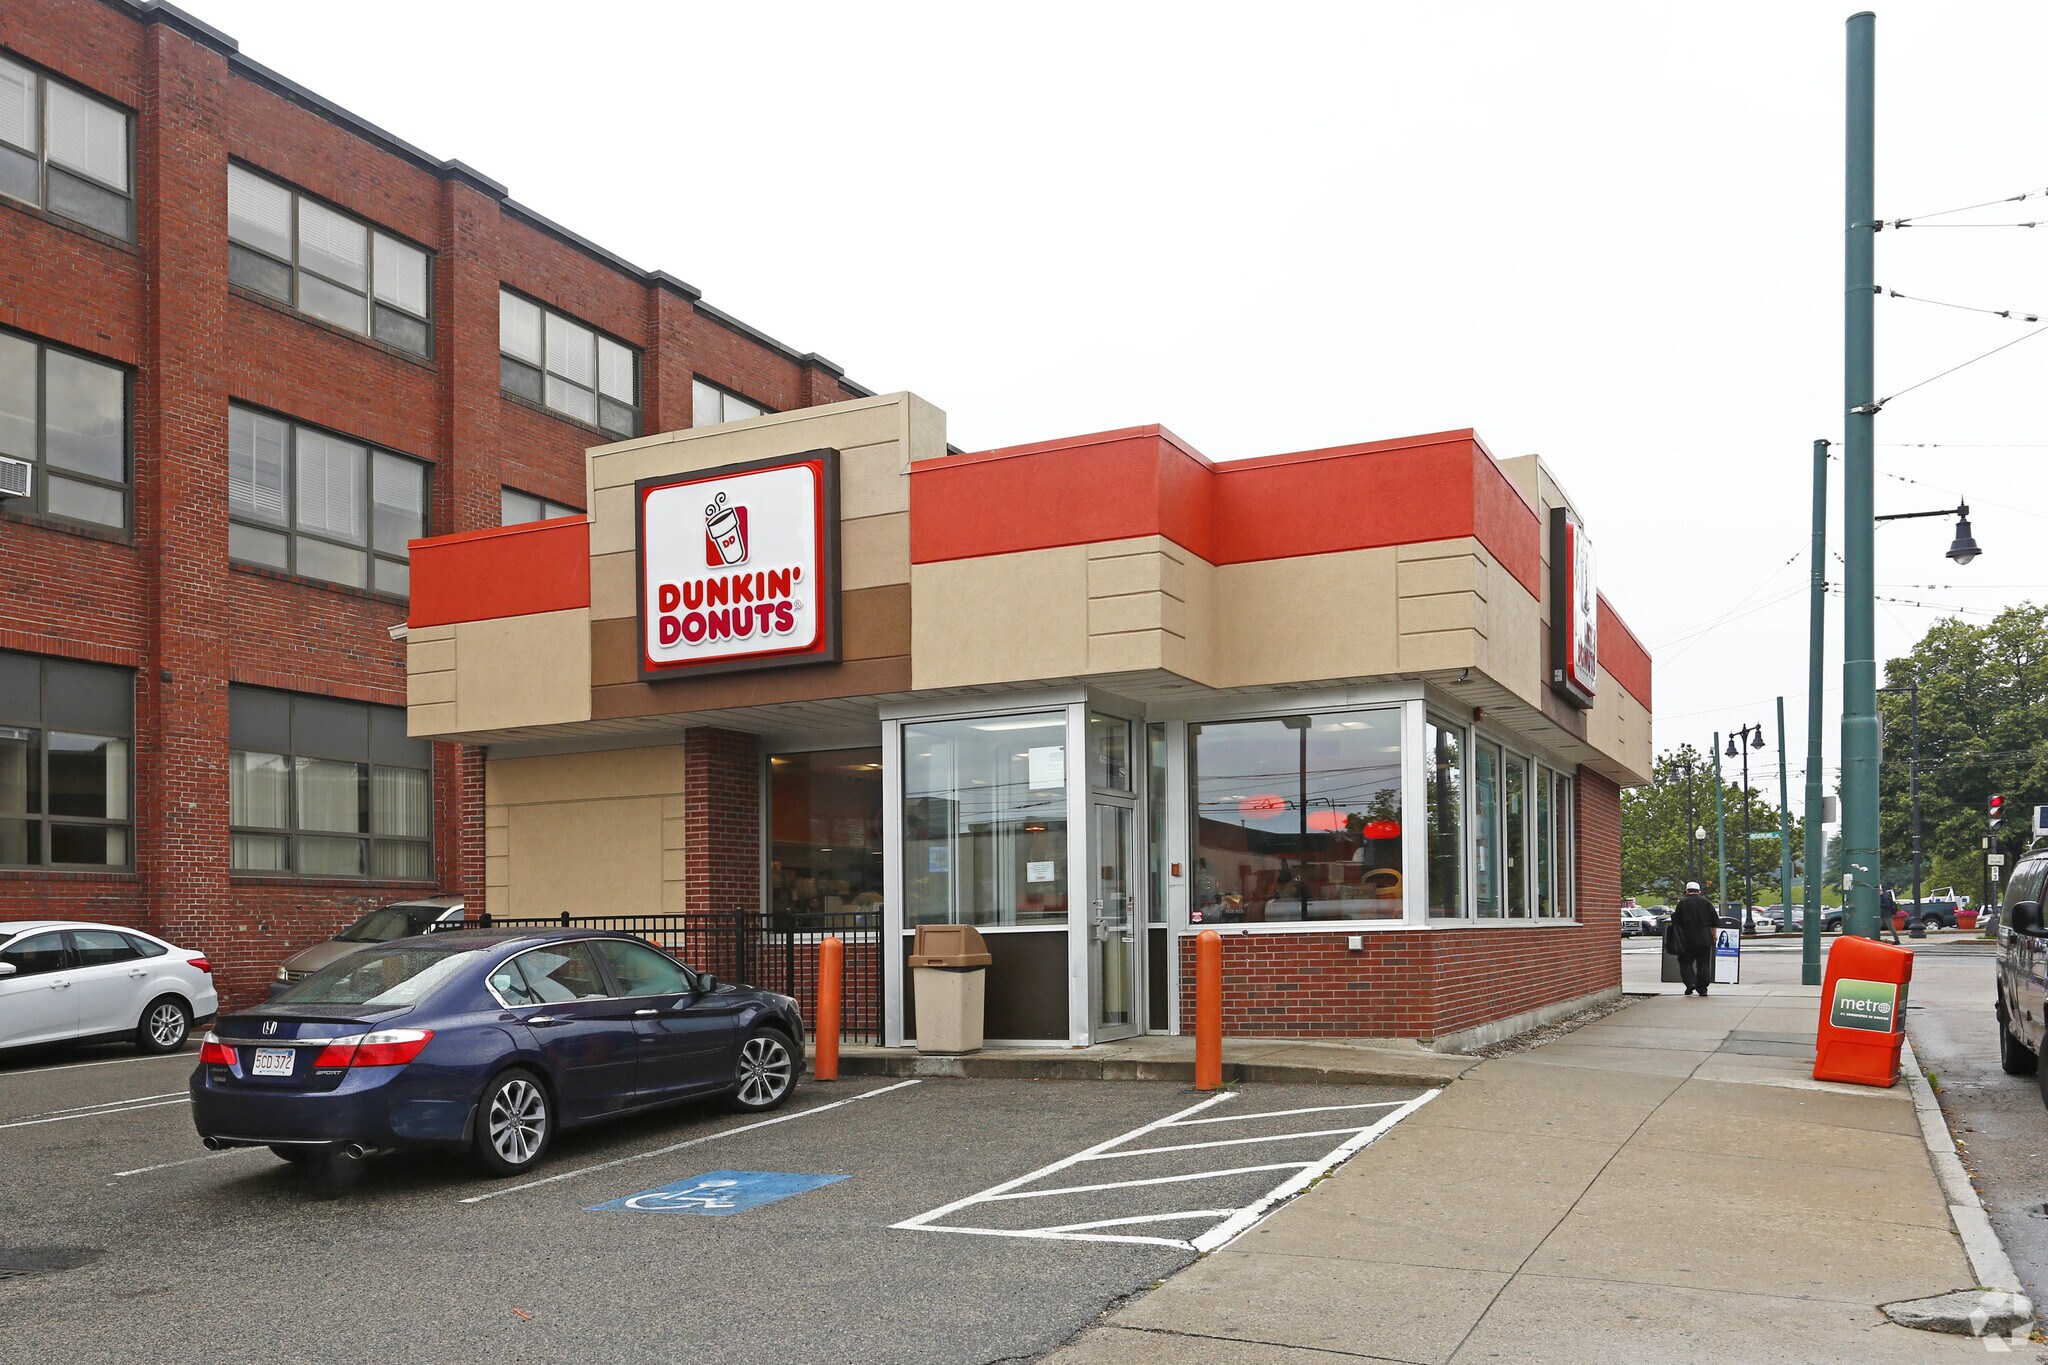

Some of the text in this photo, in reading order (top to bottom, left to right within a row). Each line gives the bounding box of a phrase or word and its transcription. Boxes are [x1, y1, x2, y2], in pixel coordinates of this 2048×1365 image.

[722, 535, 736, 549] DD
[658, 566, 802, 614] DUNKIN'
[658, 600, 795, 645] DONUTS
[1840, 998, 1891, 1014] metro
[255, 1055, 292, 1070] 5CD 372
